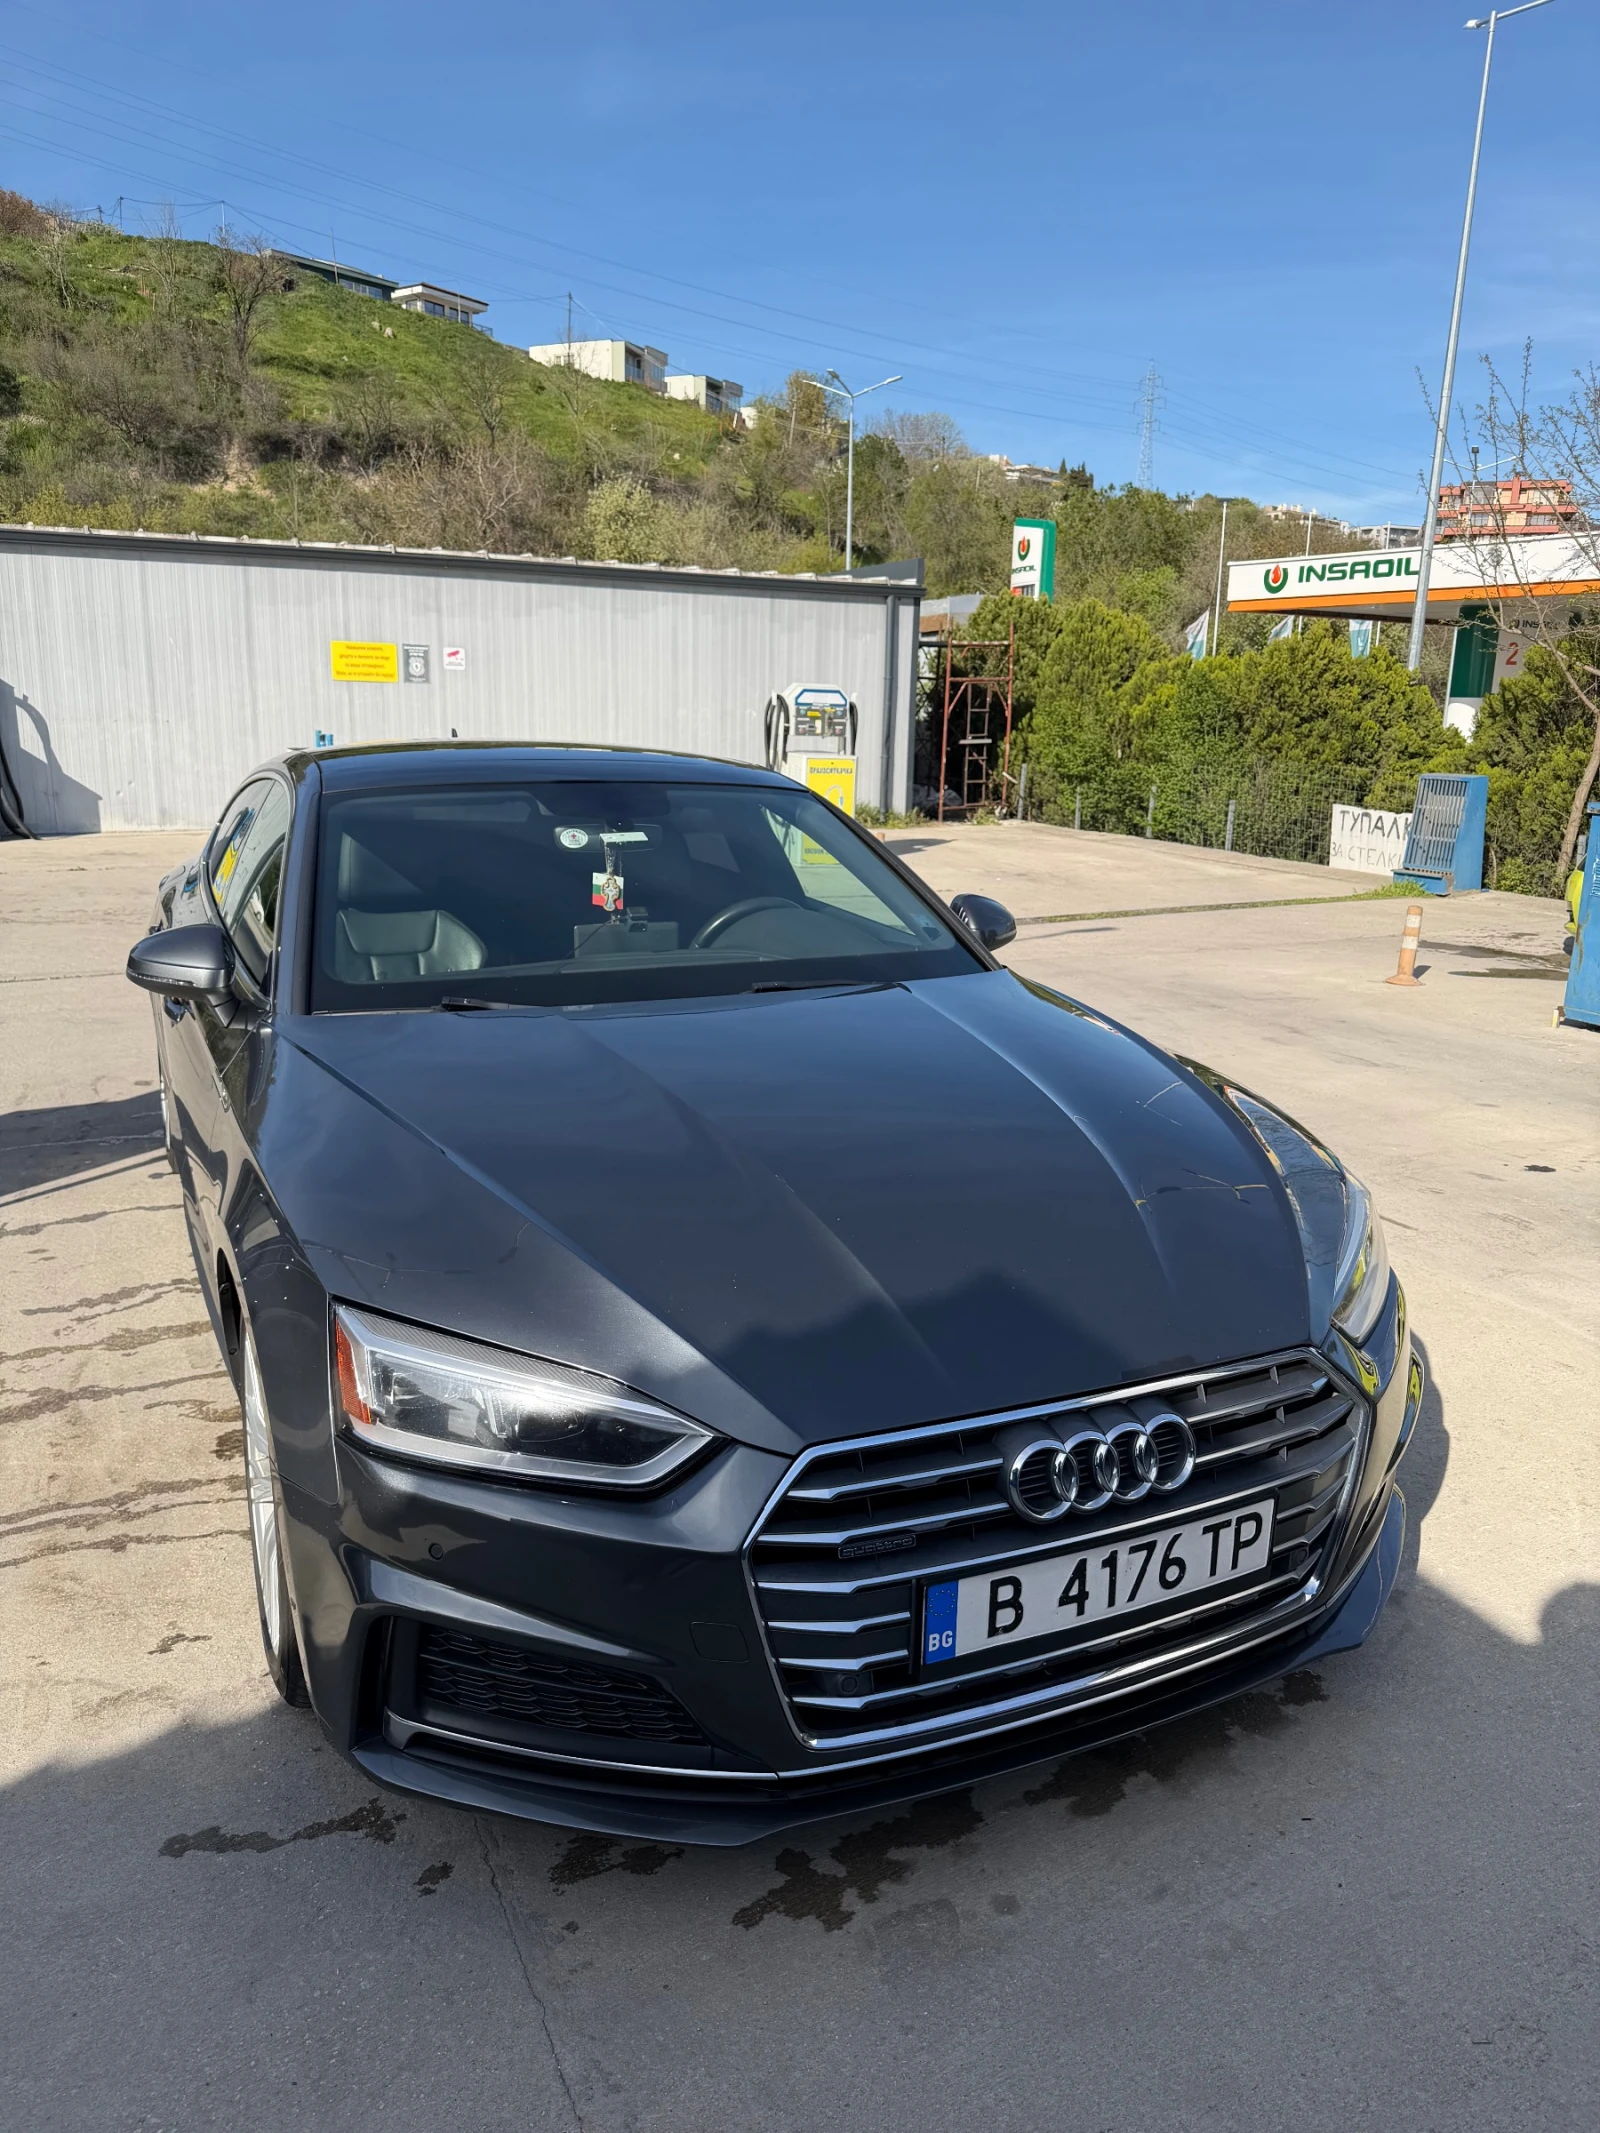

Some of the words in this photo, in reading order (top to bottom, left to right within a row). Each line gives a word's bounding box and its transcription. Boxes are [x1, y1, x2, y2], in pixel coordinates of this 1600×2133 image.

[1298, 557, 1420, 584] INSAOIL
[1505, 641, 1519, 666] 2
[1340, 810, 1412, 841] ТУПАЛК
[1331, 842, 1343, 858] ЗА
[841, 1536, 914, 1557] quattro
[987, 1575, 1025, 1638] B
[1057, 1533, 1187, 1617] 4176
[1202, 1511, 1263, 1578] TP
[928, 1630, 953, 1652] BG
